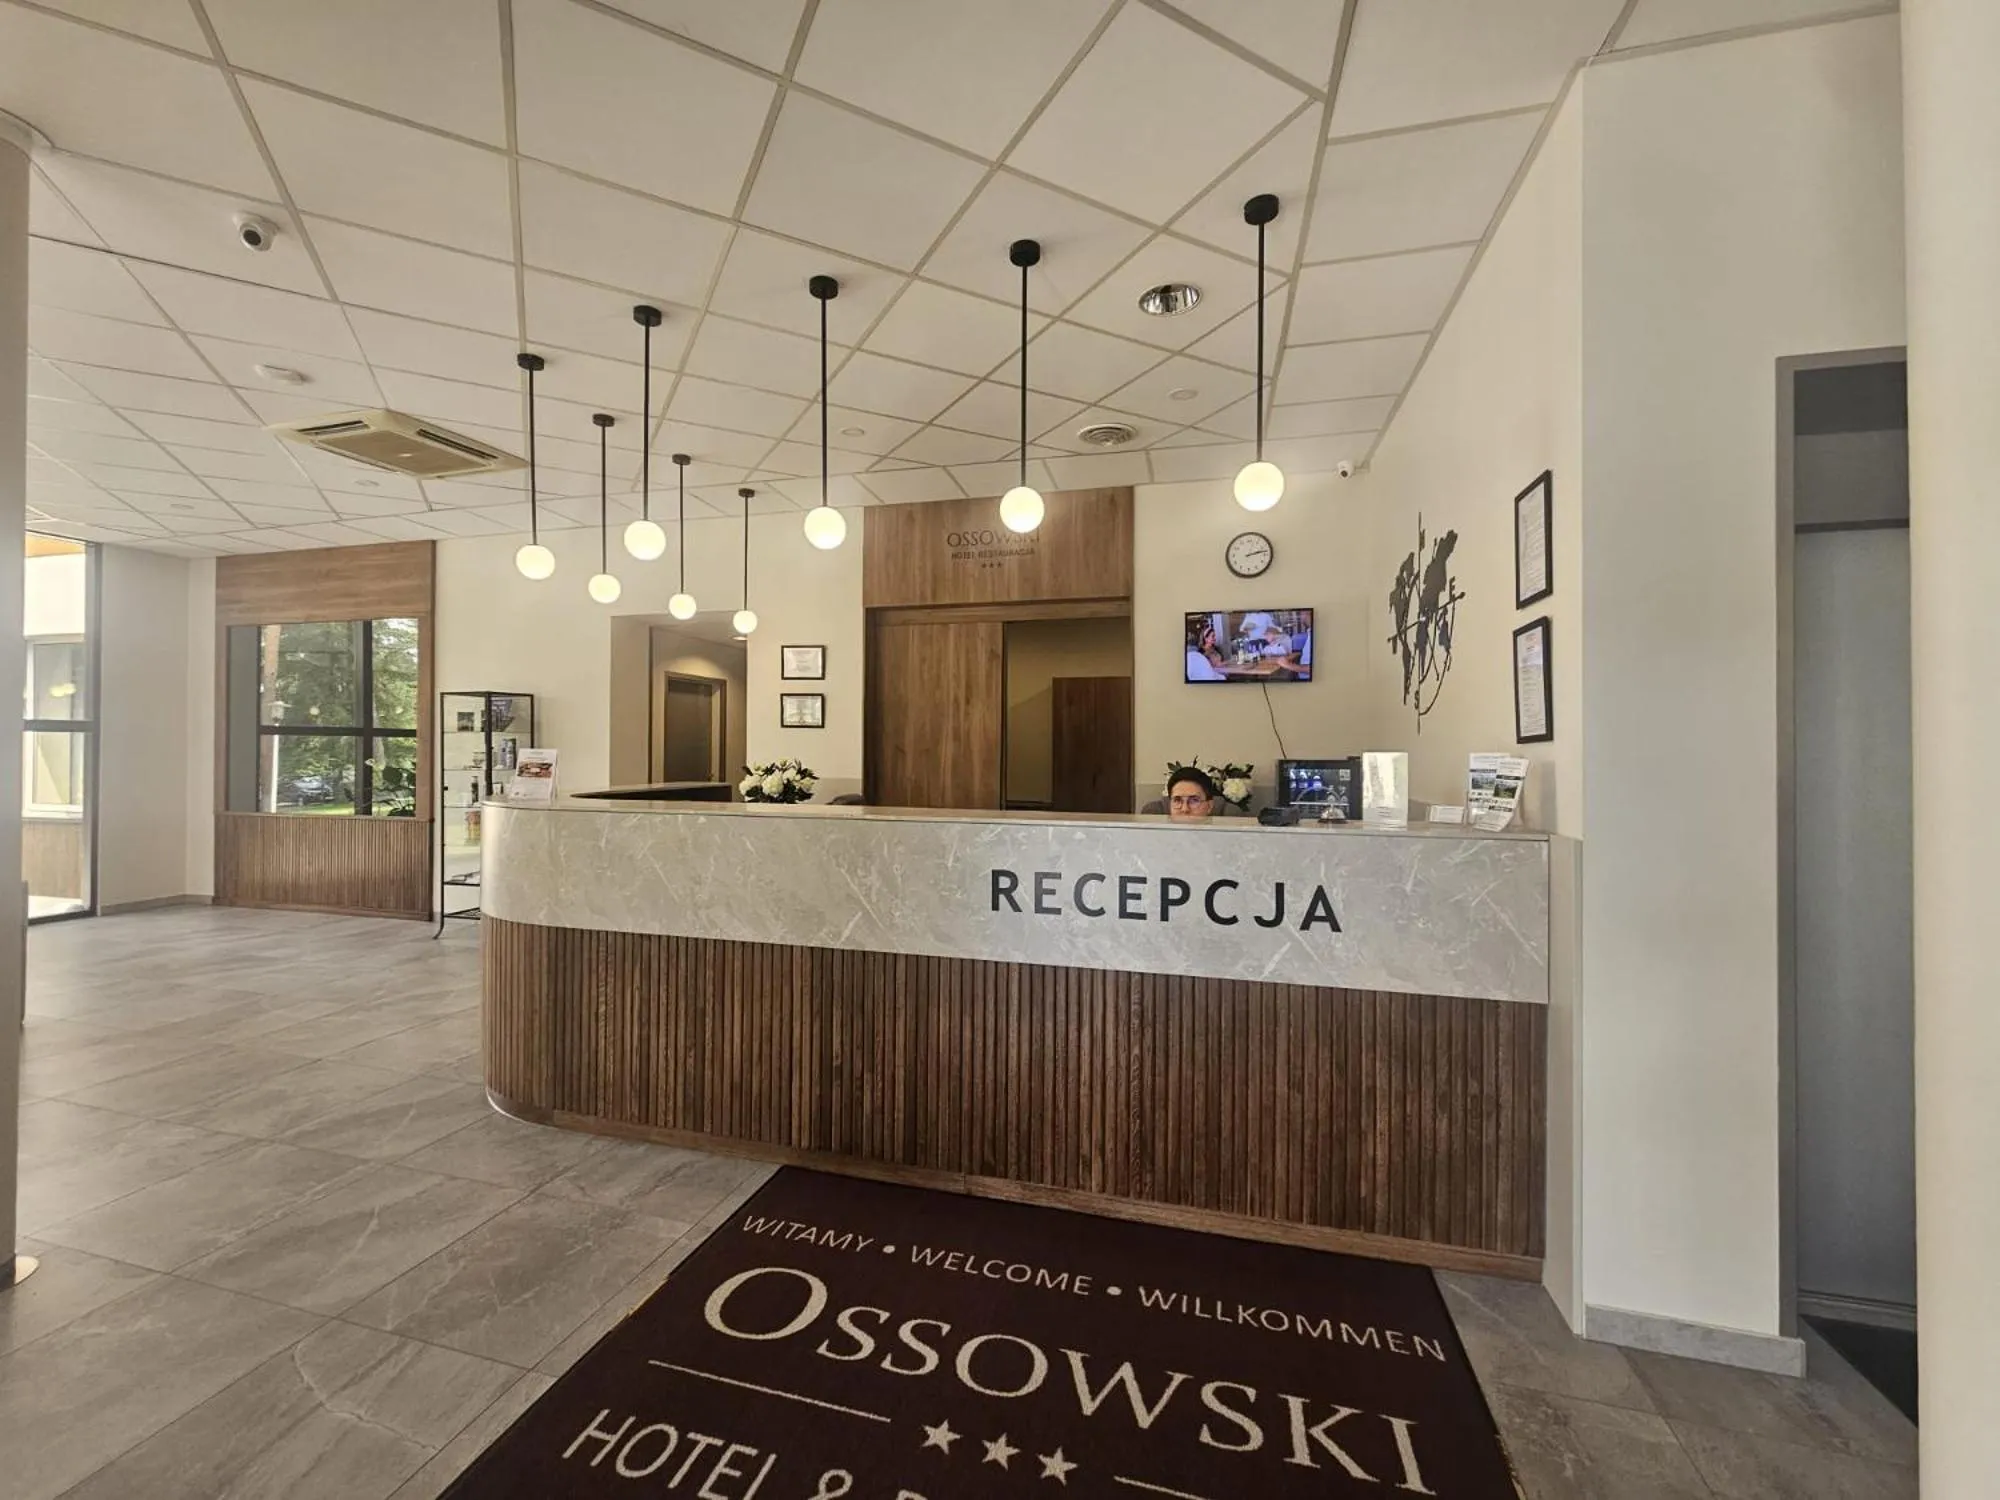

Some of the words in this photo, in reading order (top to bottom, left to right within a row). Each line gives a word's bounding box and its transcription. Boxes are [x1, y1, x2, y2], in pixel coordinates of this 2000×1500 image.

[990, 868, 1343, 933] RECEPCJA
[743, 1215, 874, 1253] WITAMY
[911, 1245, 1093, 1296] WELCOME
[1138, 1286, 1447, 1362] WILLKOMMEN
